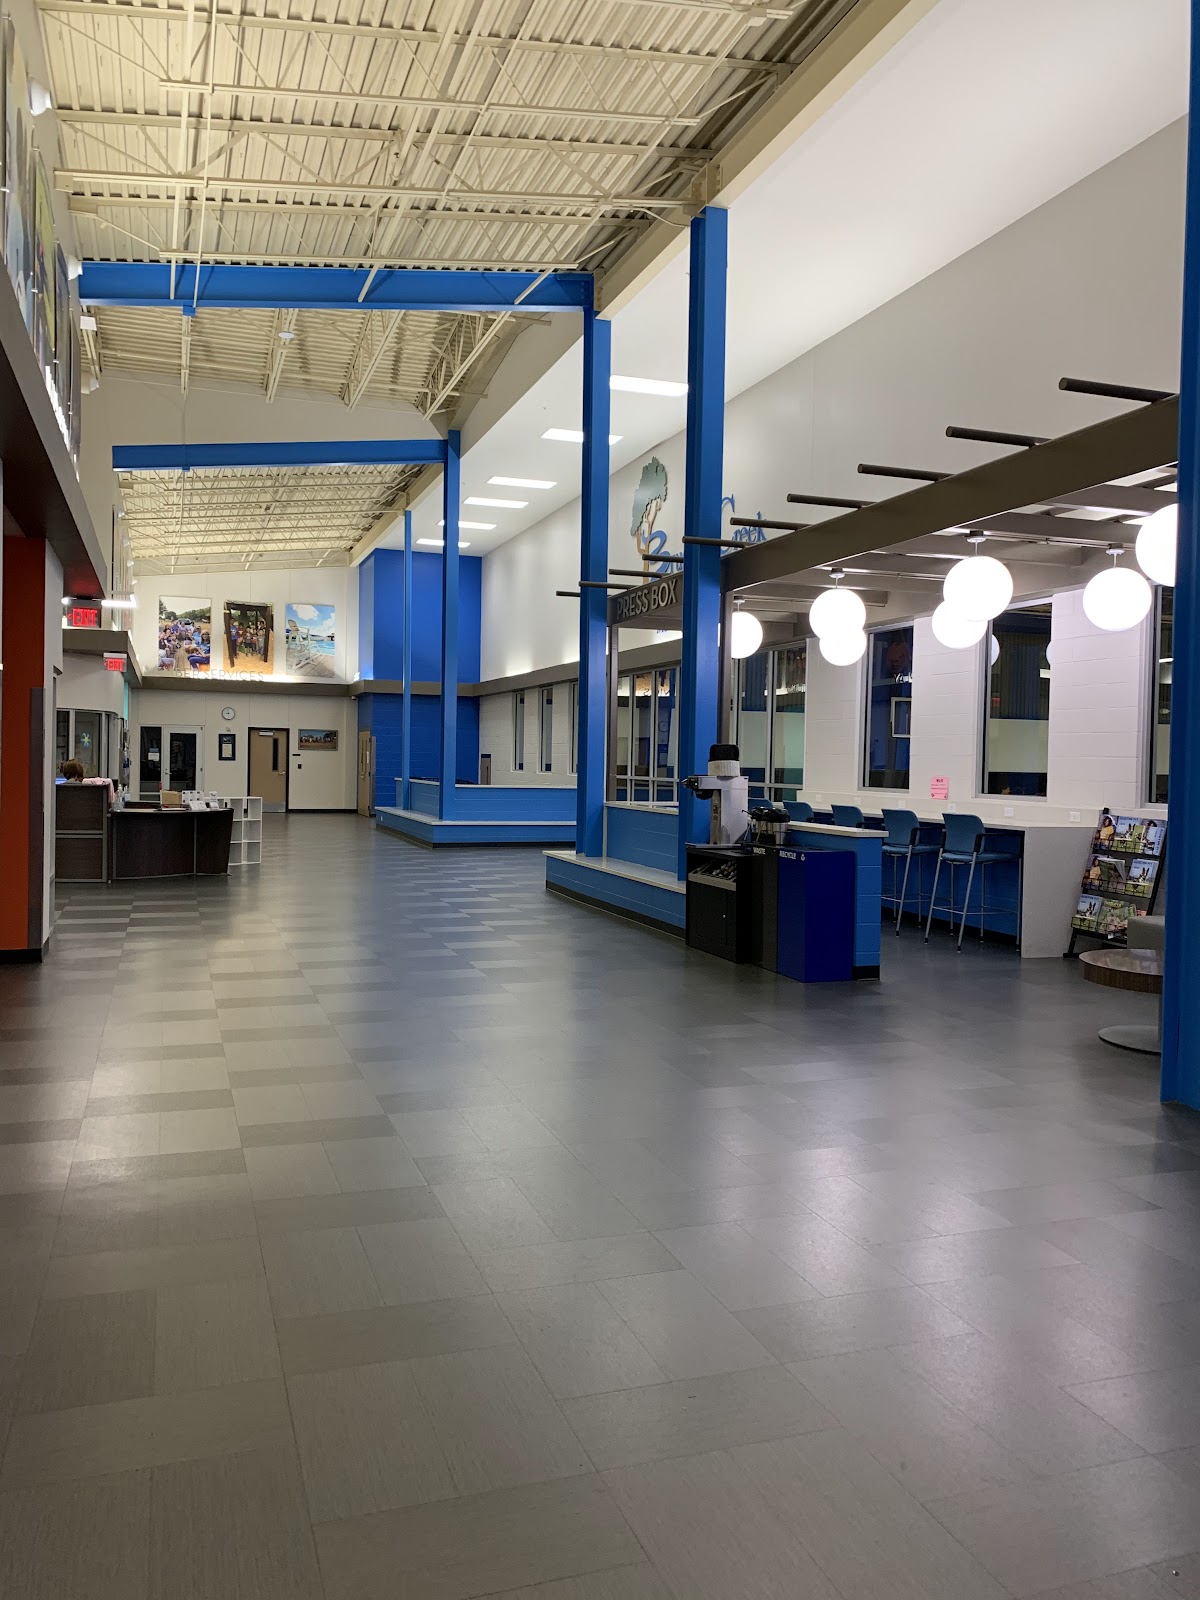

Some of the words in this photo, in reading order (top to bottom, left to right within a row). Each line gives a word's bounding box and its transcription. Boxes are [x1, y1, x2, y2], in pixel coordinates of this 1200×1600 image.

[616, 589, 649, 620] PRESS
[651, 579, 678, 610] BOX
[72, 608, 98, 627] EXIT
[107, 658, 124, 671] EXIT
[203, 668, 264, 681] SERVICES
